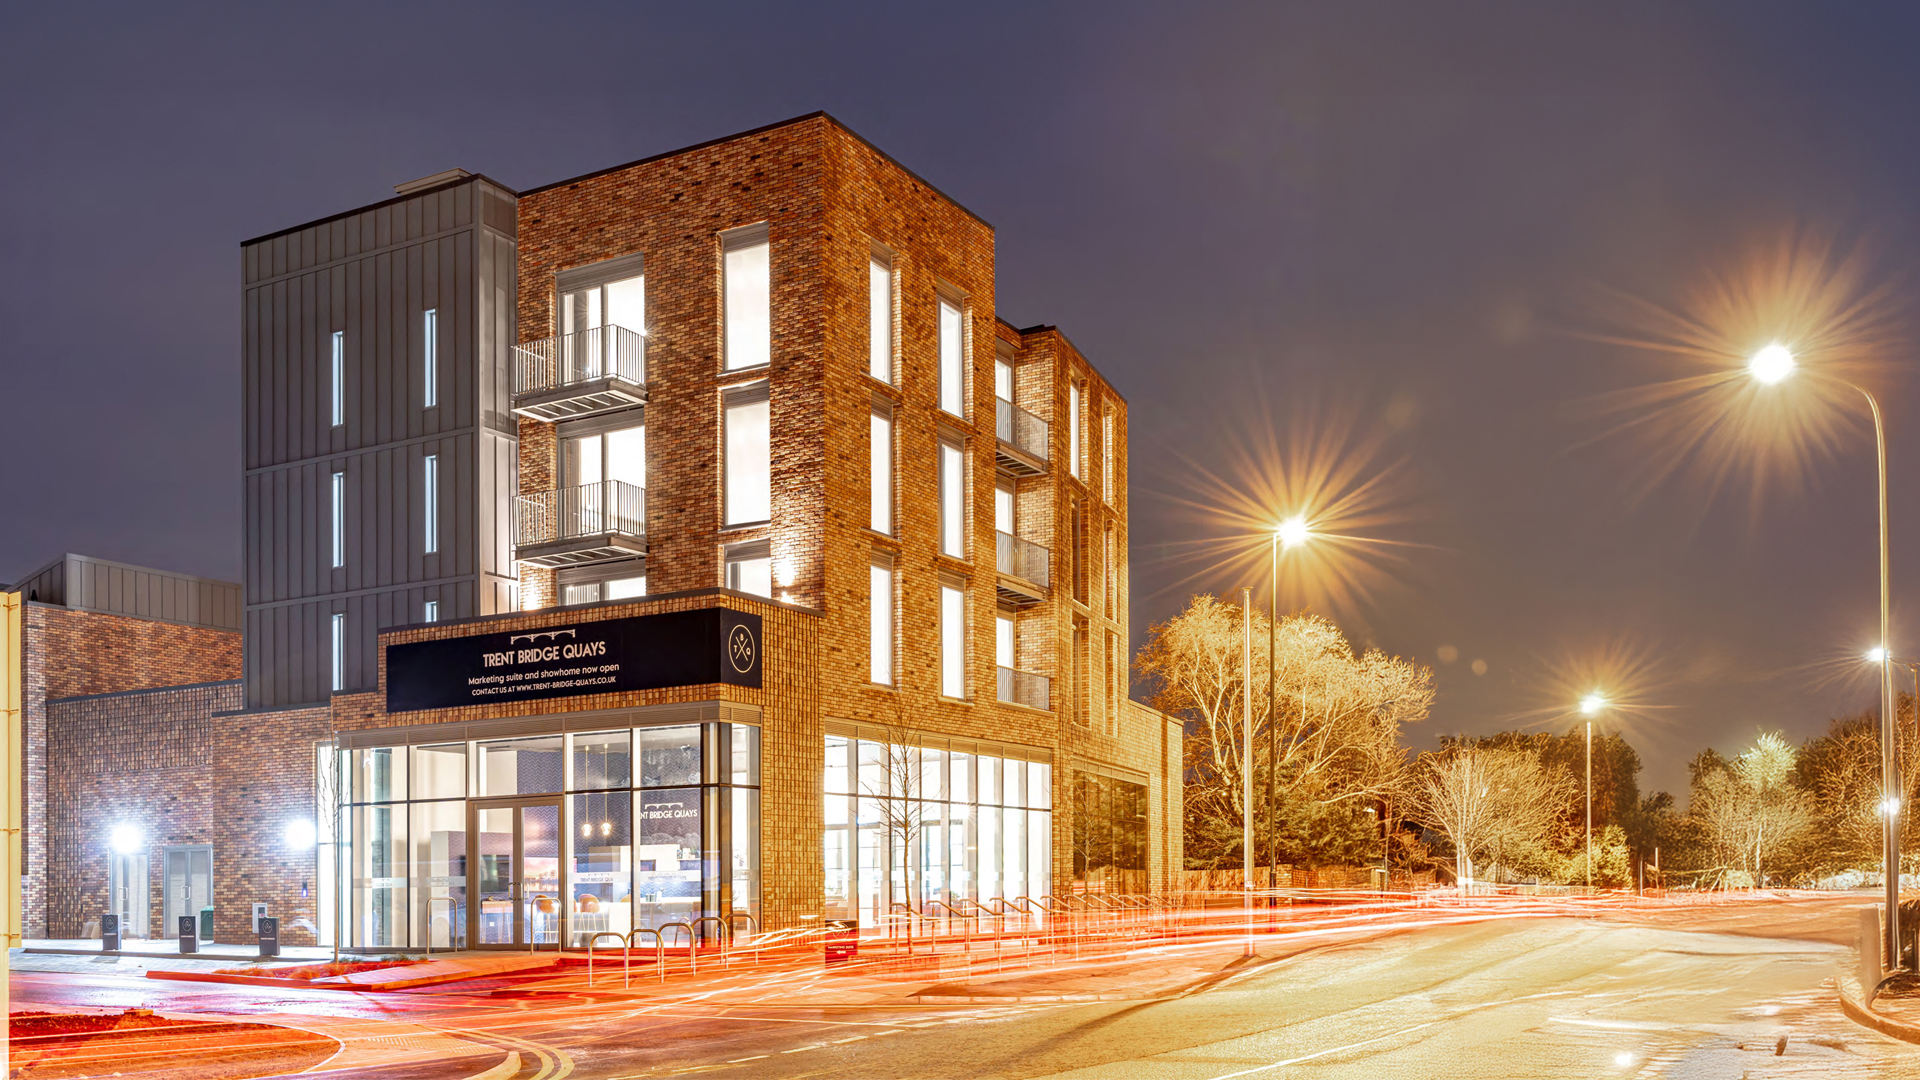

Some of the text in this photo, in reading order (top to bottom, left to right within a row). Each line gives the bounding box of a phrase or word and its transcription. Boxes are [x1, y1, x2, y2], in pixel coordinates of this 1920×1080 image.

[482, 641, 606, 667] TRENT BRIDGE QUAYS
[468, 664, 619, 685] Marketing suite and showhome now open
[472, 687, 499, 696] CONTACT
[516, 676, 616, 691] WWW.TRENT-BRIDGE-QUAYS.CO.UK
[649, 810, 673, 819] BRIDGE
[674, 809, 698, 818] QUAYS
